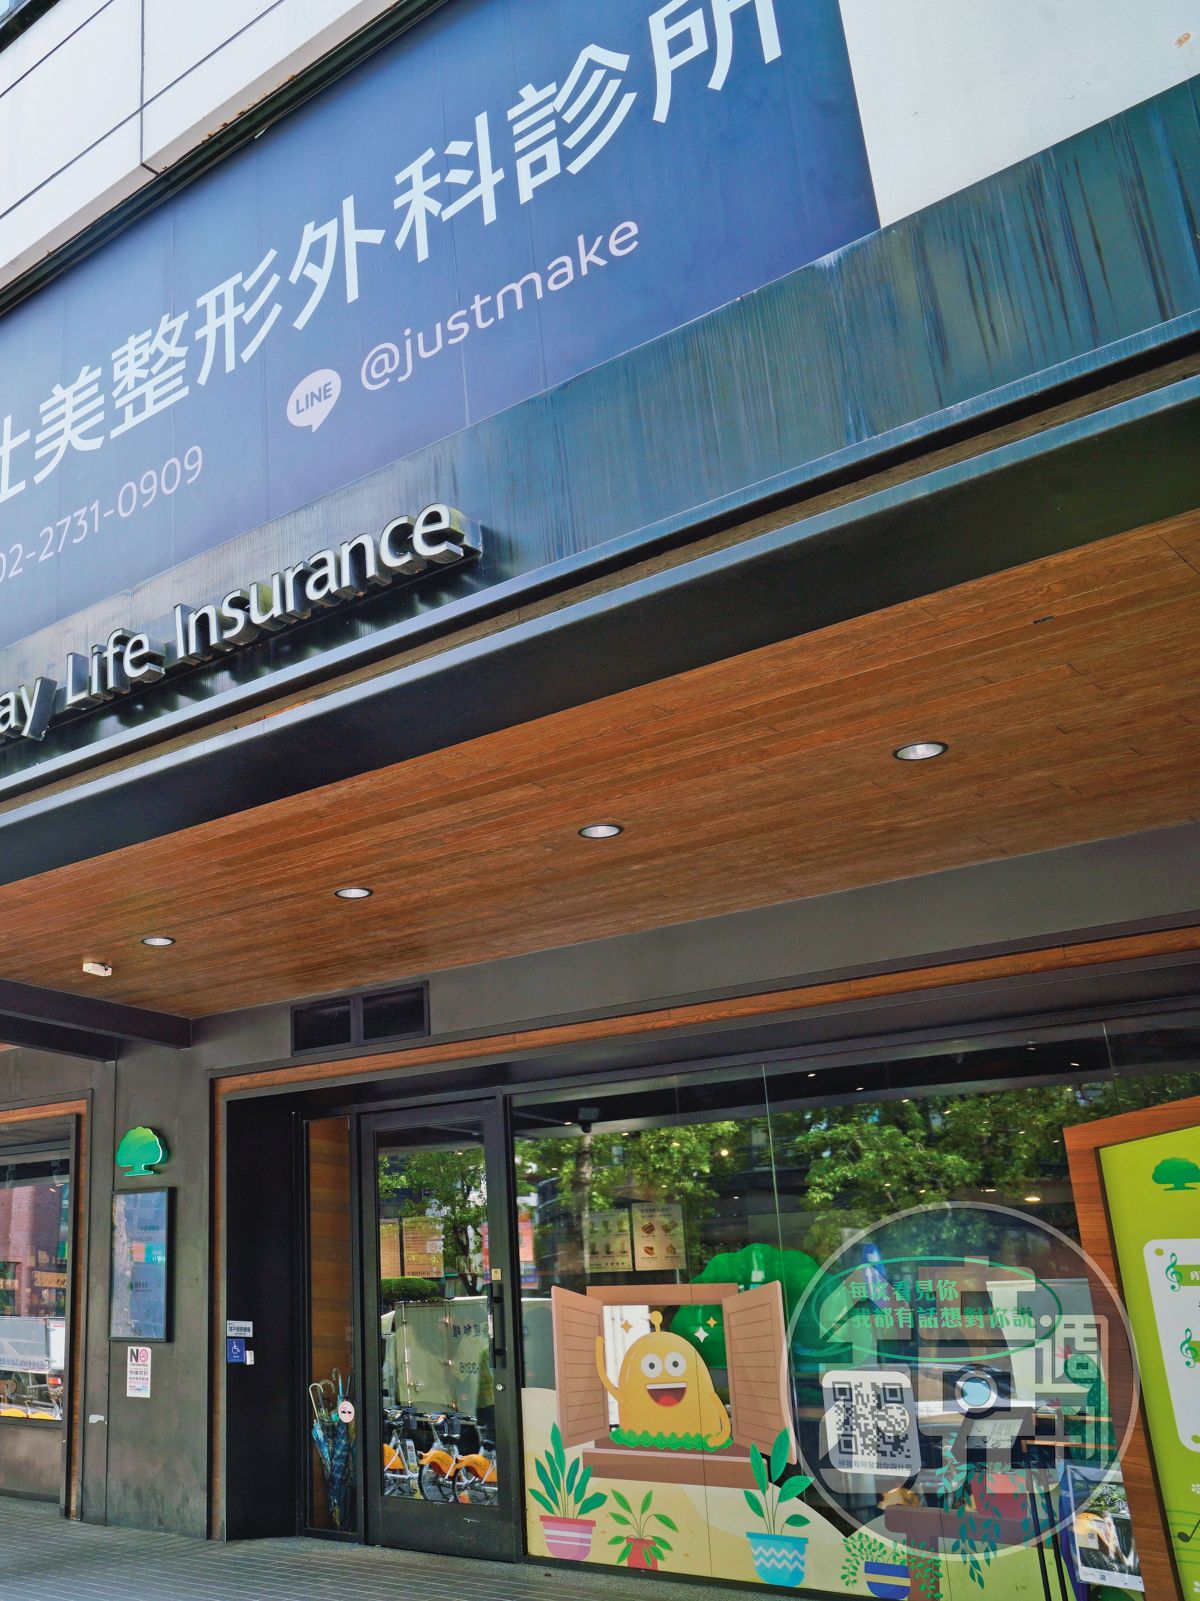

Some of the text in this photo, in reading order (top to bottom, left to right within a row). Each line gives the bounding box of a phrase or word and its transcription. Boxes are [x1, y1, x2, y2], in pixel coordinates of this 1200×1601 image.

[360, 221, 640, 391] @justmake
[294, 381, 334, 415] LINE
[66, 627, 158, 706] Life
[173, 502, 464, 659] Insurance
[851, 1280, 960, 1302] 每次看見你
[851, 1306, 1037, 1329] 我都有話想對你說
